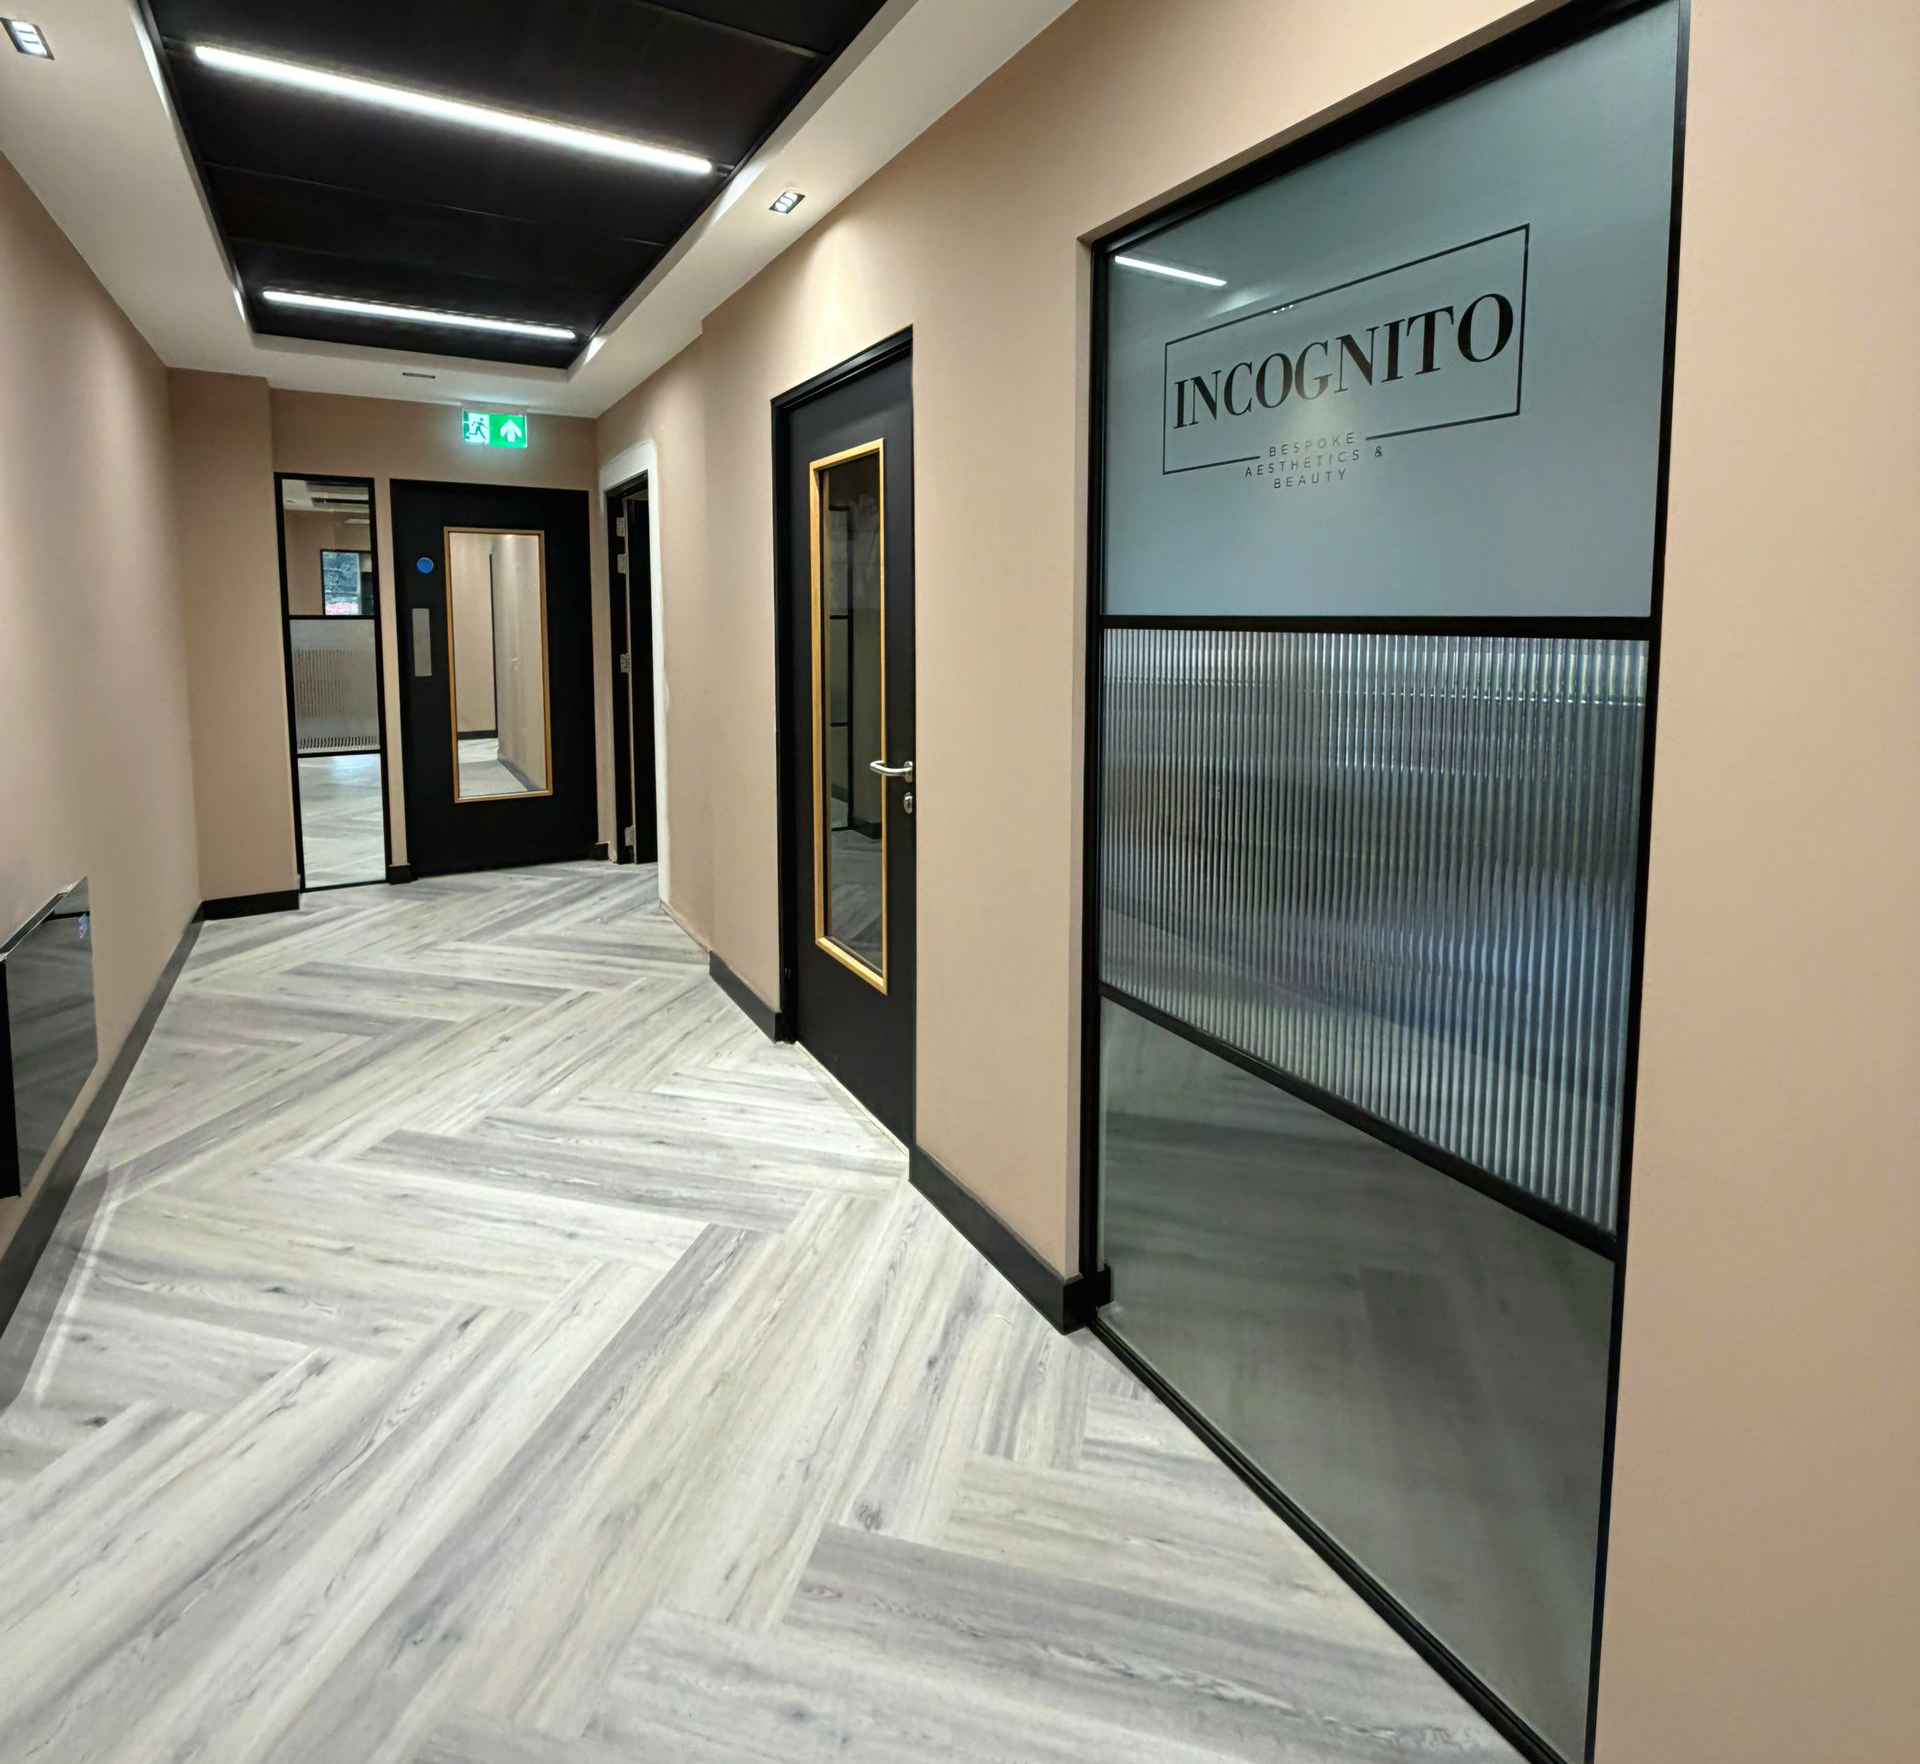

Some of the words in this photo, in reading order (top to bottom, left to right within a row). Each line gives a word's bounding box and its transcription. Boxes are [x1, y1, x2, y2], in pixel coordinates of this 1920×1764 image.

[1173, 293, 1514, 429] INCOGNITO
[1269, 432, 1355, 457] BESPOKE
[1244, 449, 1360, 477] AESTHETICS
[1374, 445, 1384, 458] &
[1273, 468, 1347, 488] BEAUTY
